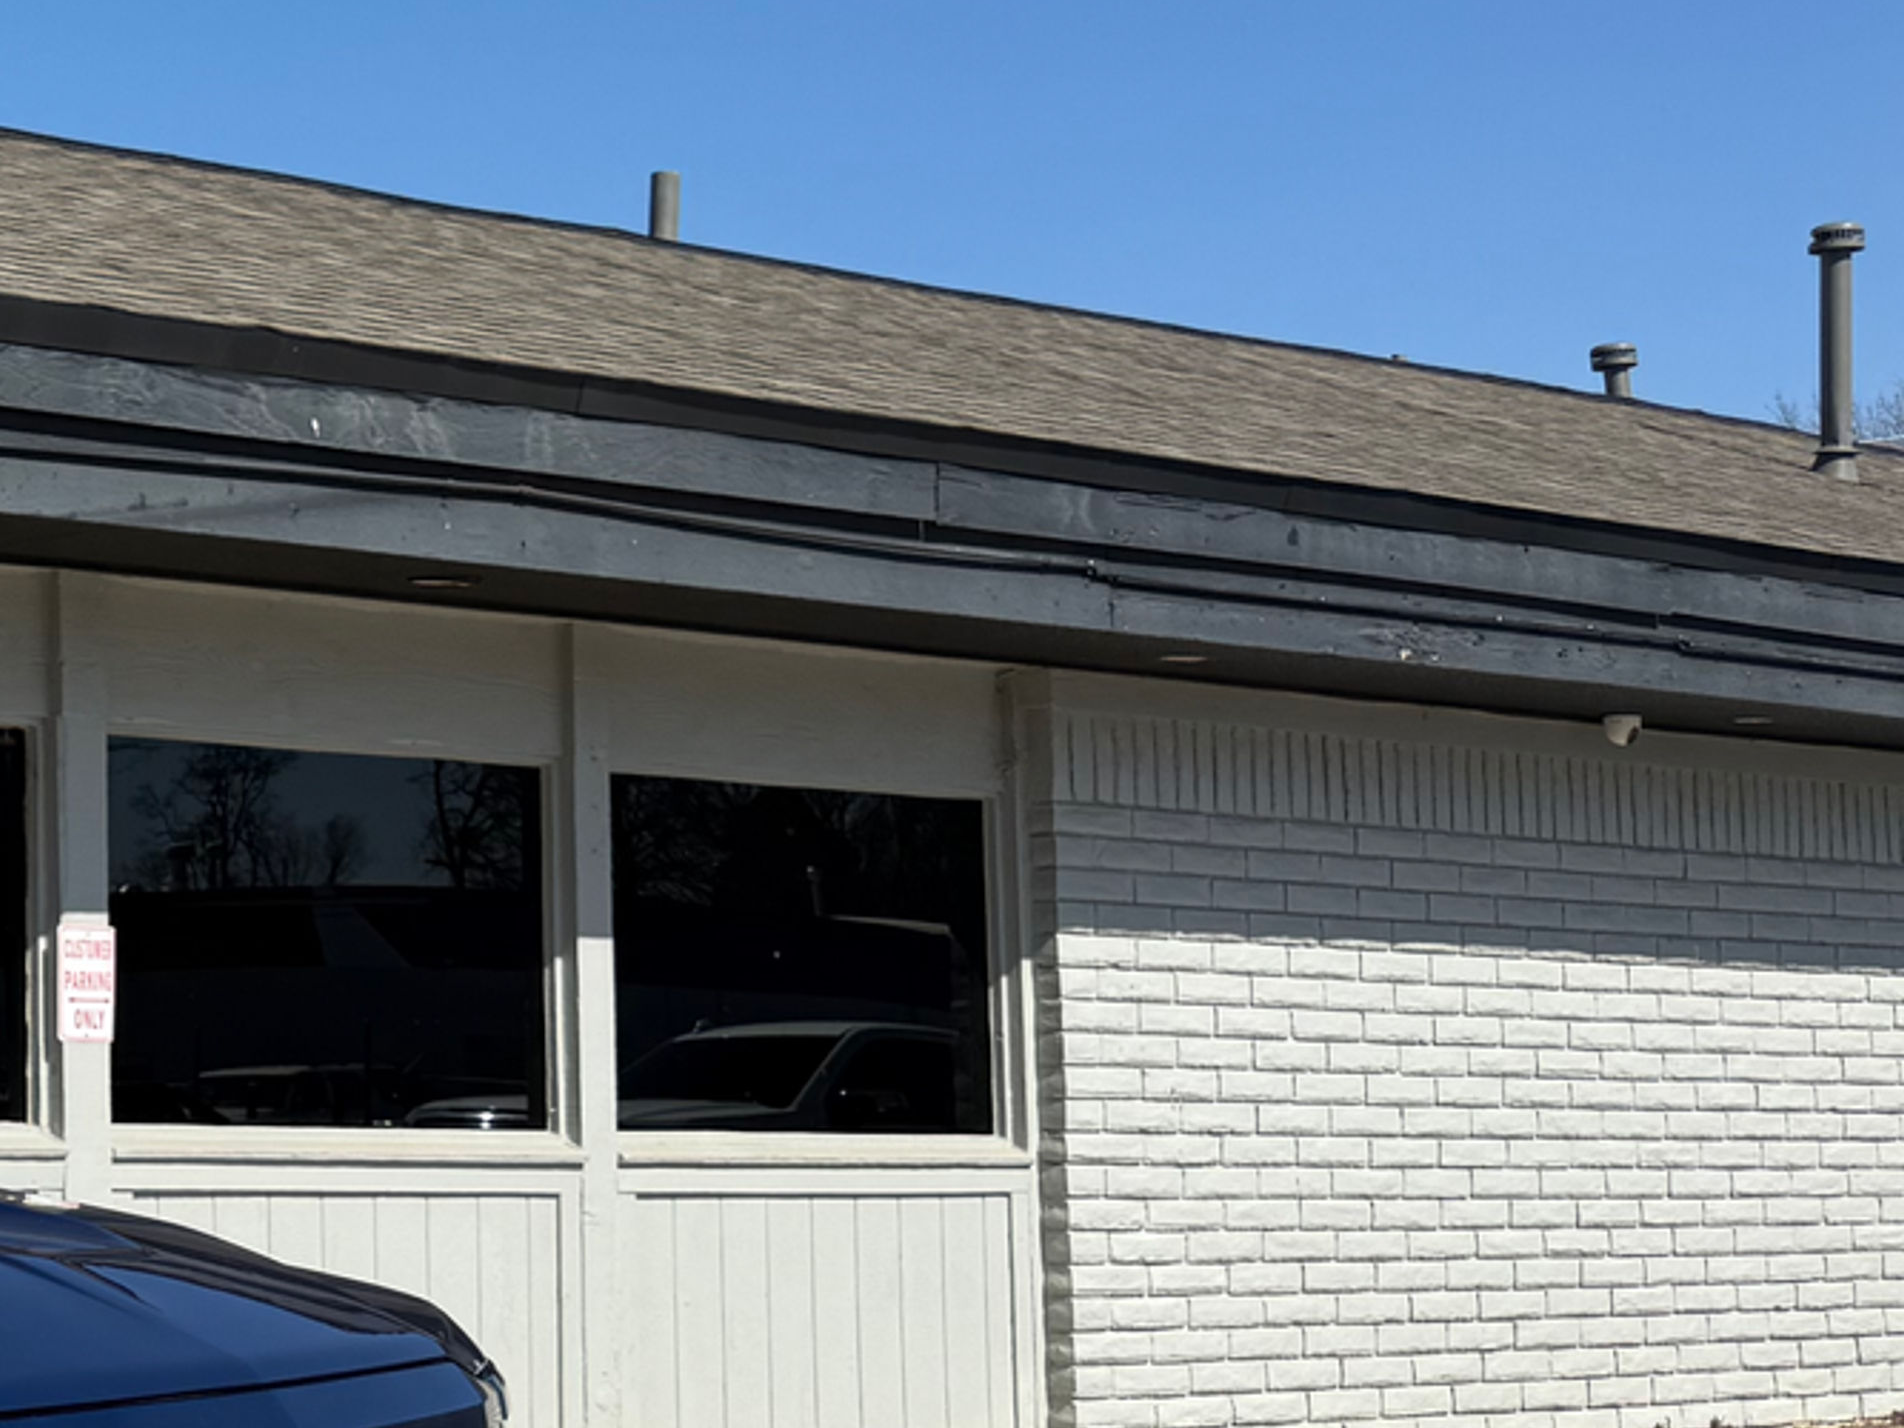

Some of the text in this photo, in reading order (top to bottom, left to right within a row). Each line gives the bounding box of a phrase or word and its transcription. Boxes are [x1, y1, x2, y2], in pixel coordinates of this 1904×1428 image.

[64, 938, 112, 960] CUSTOMER
[64, 970, 112, 992] PARKING
[73, 1008, 106, 1030] ONLY
